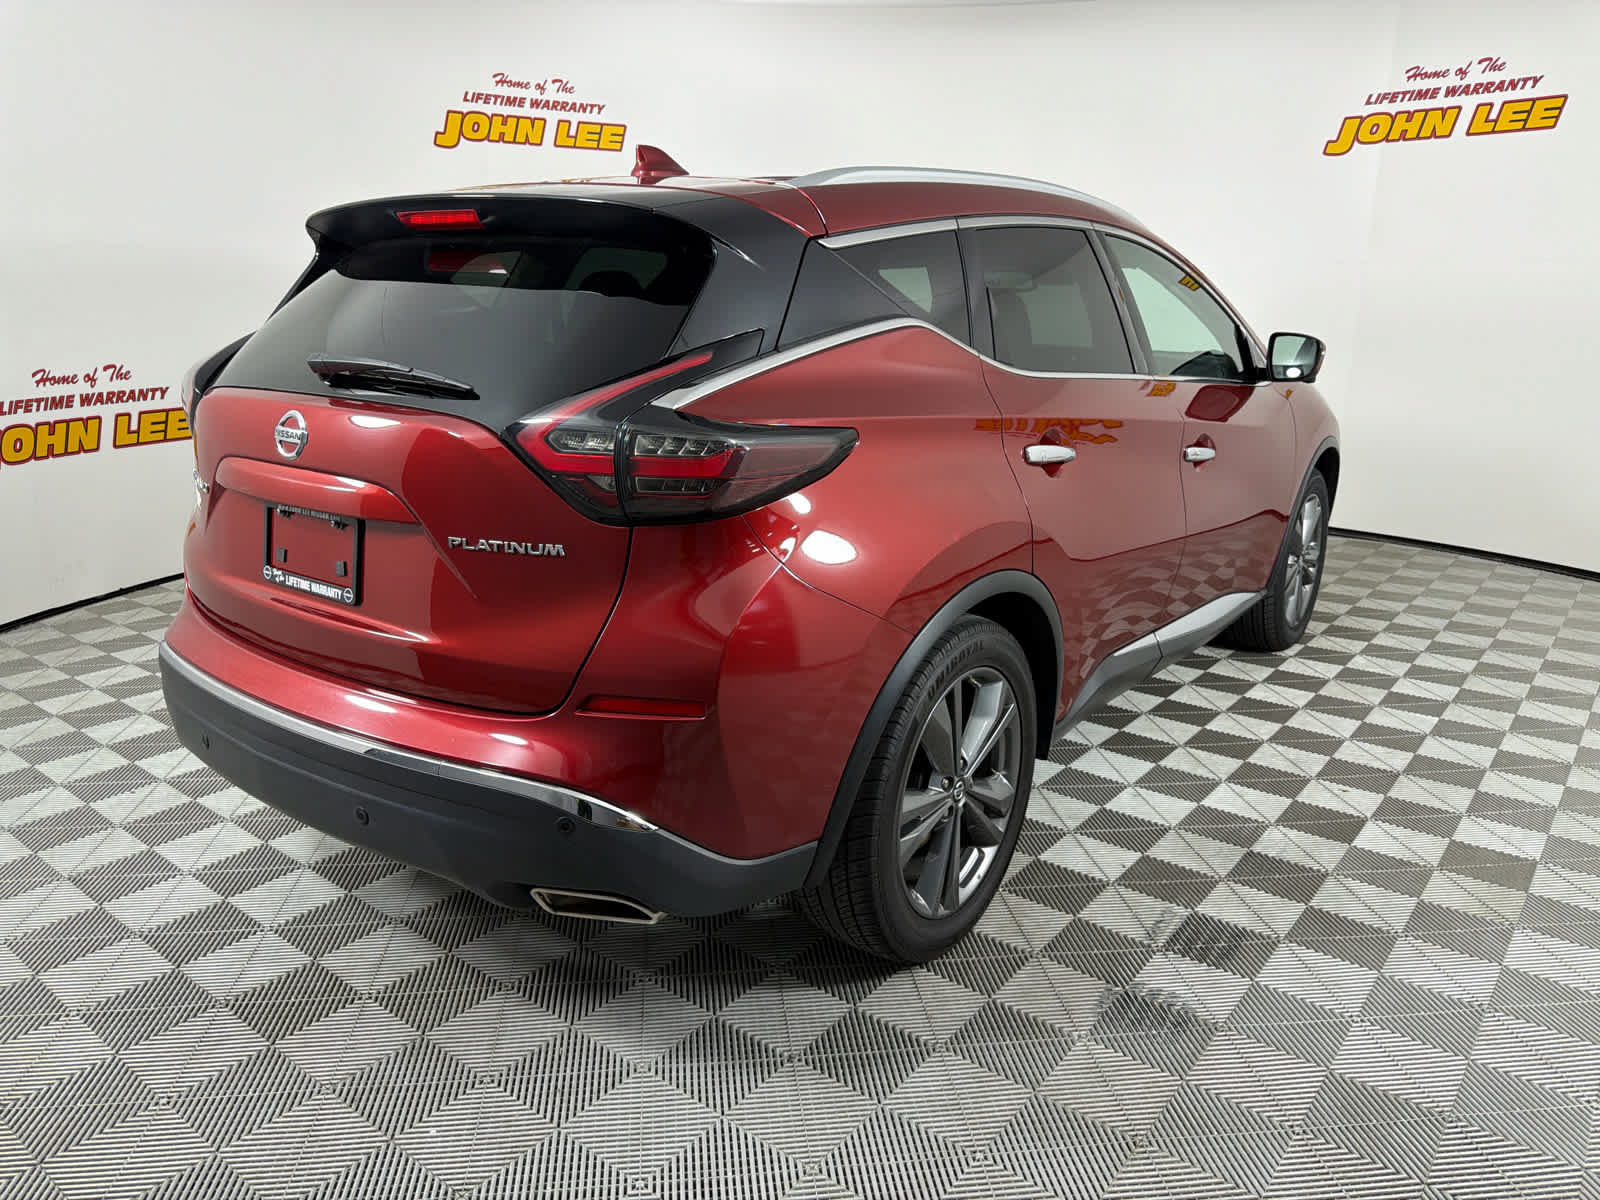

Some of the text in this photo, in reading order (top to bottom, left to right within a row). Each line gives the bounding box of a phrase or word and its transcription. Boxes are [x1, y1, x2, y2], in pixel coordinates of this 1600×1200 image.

[1405, 57, 1506, 82] Home of The
[492, 72, 575, 96] Home of The
[1364, 75, 1545, 106] LIFETIME WARRANTY
[463, 91, 606, 115] LIFETIME WARRANTY
[434, 109, 627, 152] JOHN LEE
[1322, 94, 1569, 156] JOHN LEE
[31, 363, 132, 388] Home of The
[0, 386, 170, 416] LIFETIME WARRANTY
[0, 407, 194, 467] OHN LEE
[447, 536, 566, 556] PLATINUM
[285, 574, 311, 592] LIFETIME
[311, 582, 343, 600] WARRANTY
